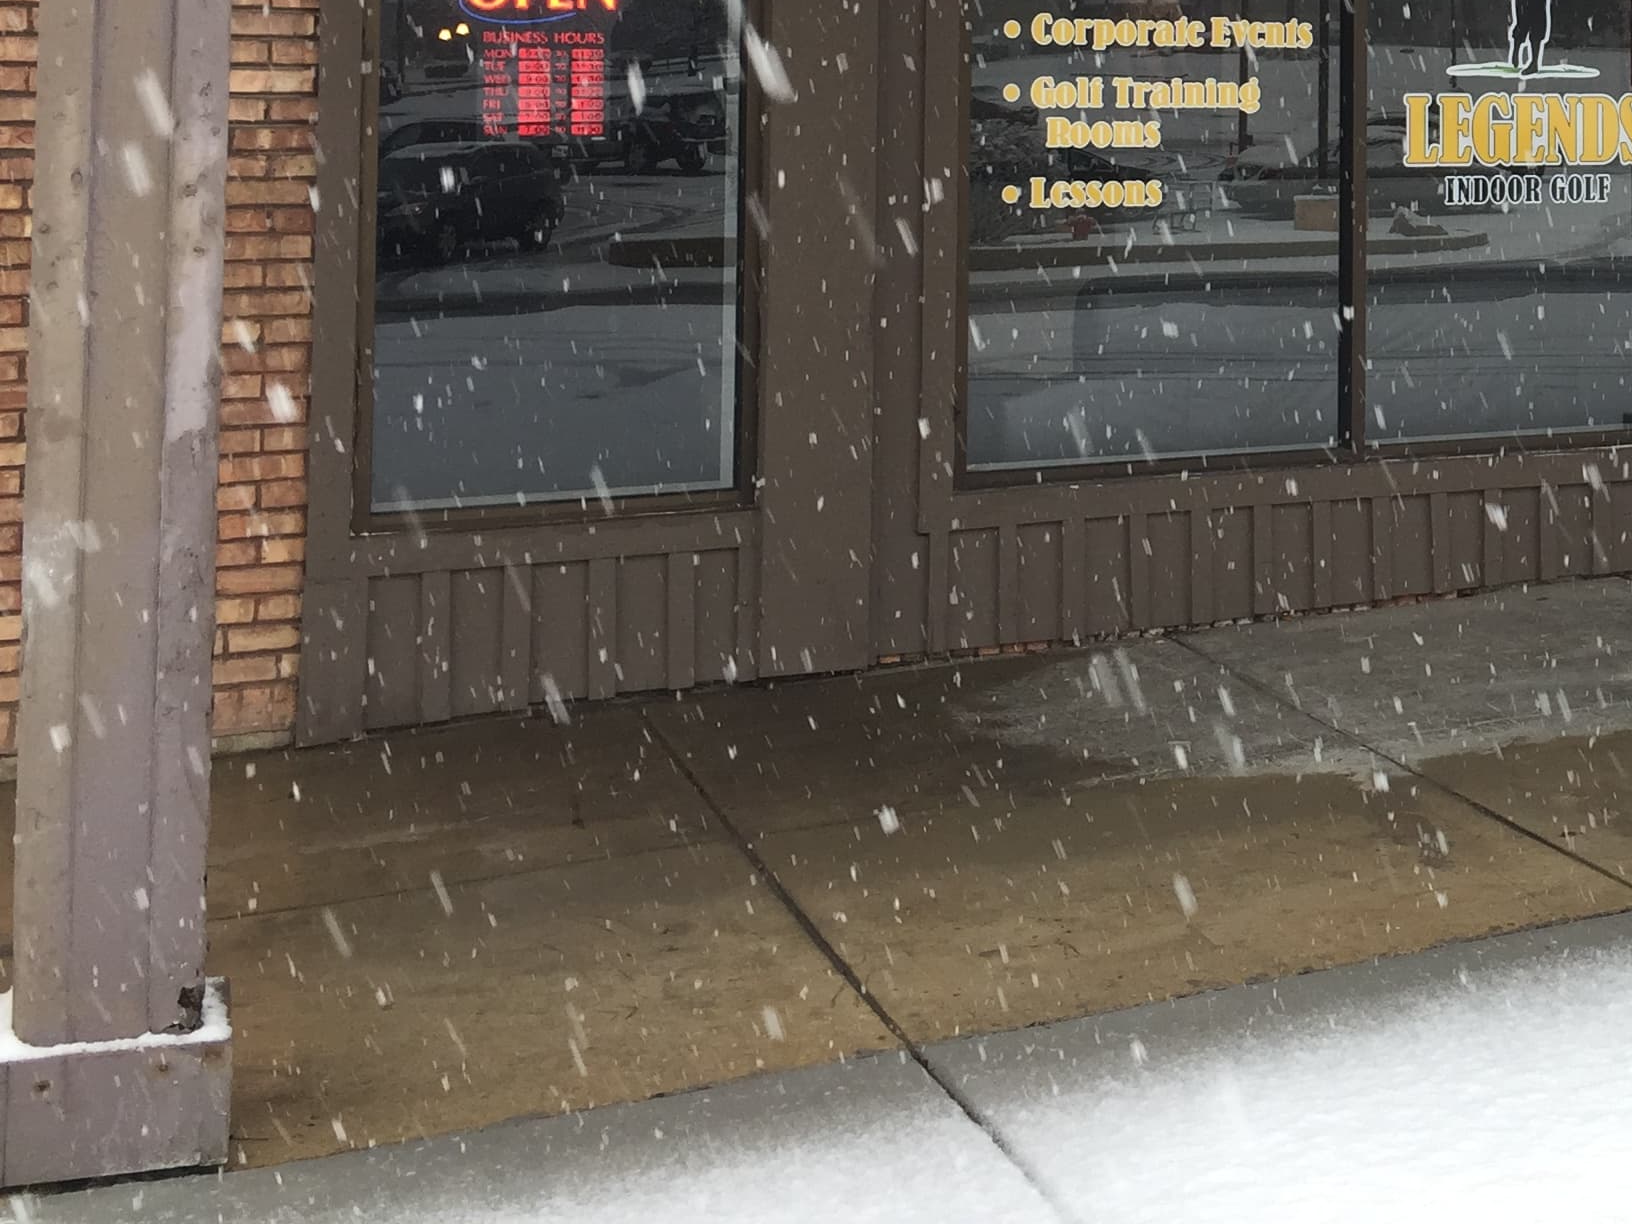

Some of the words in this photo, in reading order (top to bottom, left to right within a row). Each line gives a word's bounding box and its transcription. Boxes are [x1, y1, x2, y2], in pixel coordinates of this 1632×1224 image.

[482, 31, 548, 44] BUSINESS
[553, 32, 605, 44] HOURS
[1031, 13, 1205, 50] Corporate
[1210, 16, 1313, 49] Events
[1030, 76, 1104, 109] Golf
[1112, 77, 1261, 114] Training
[1046, 117, 1161, 149] Rooms
[1029, 177, 1163, 208] Lessons
[1444, 175, 1542, 205] INDOOR
[1550, 174, 1611, 204] GOLF
